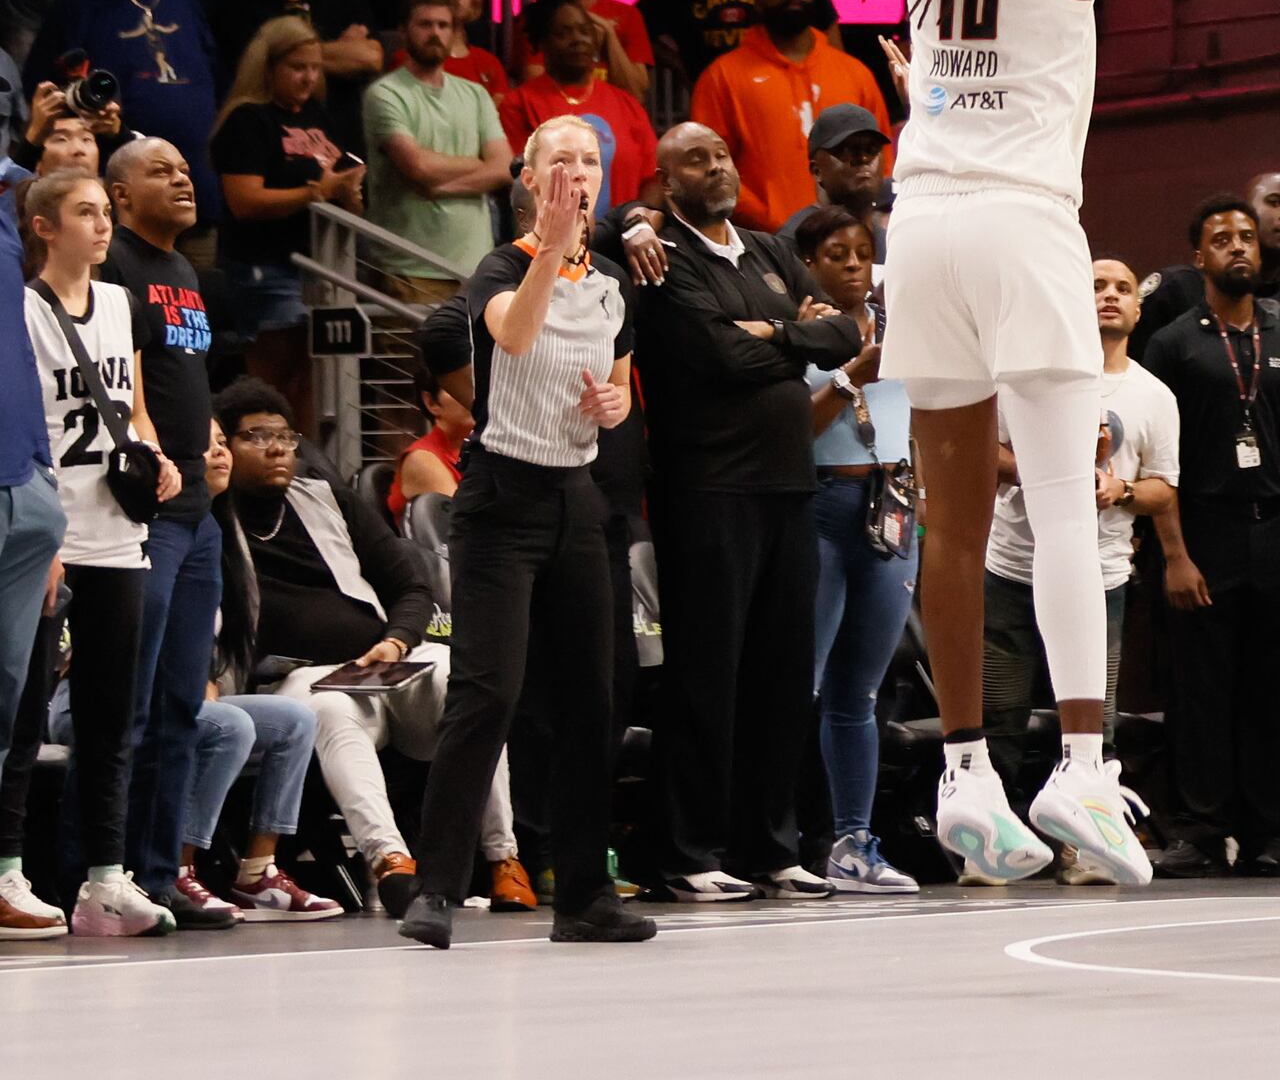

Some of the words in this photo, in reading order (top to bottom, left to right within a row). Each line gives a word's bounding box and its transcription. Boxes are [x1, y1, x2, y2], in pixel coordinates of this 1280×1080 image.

[929, 49, 998, 78] HOWARD
[950, 90, 1008, 110] AT&T
[163, 305, 182, 326] IS
[181, 307, 211, 332] THE
[325, 320, 352, 344] 111
[165, 325, 213, 352] DREAM
